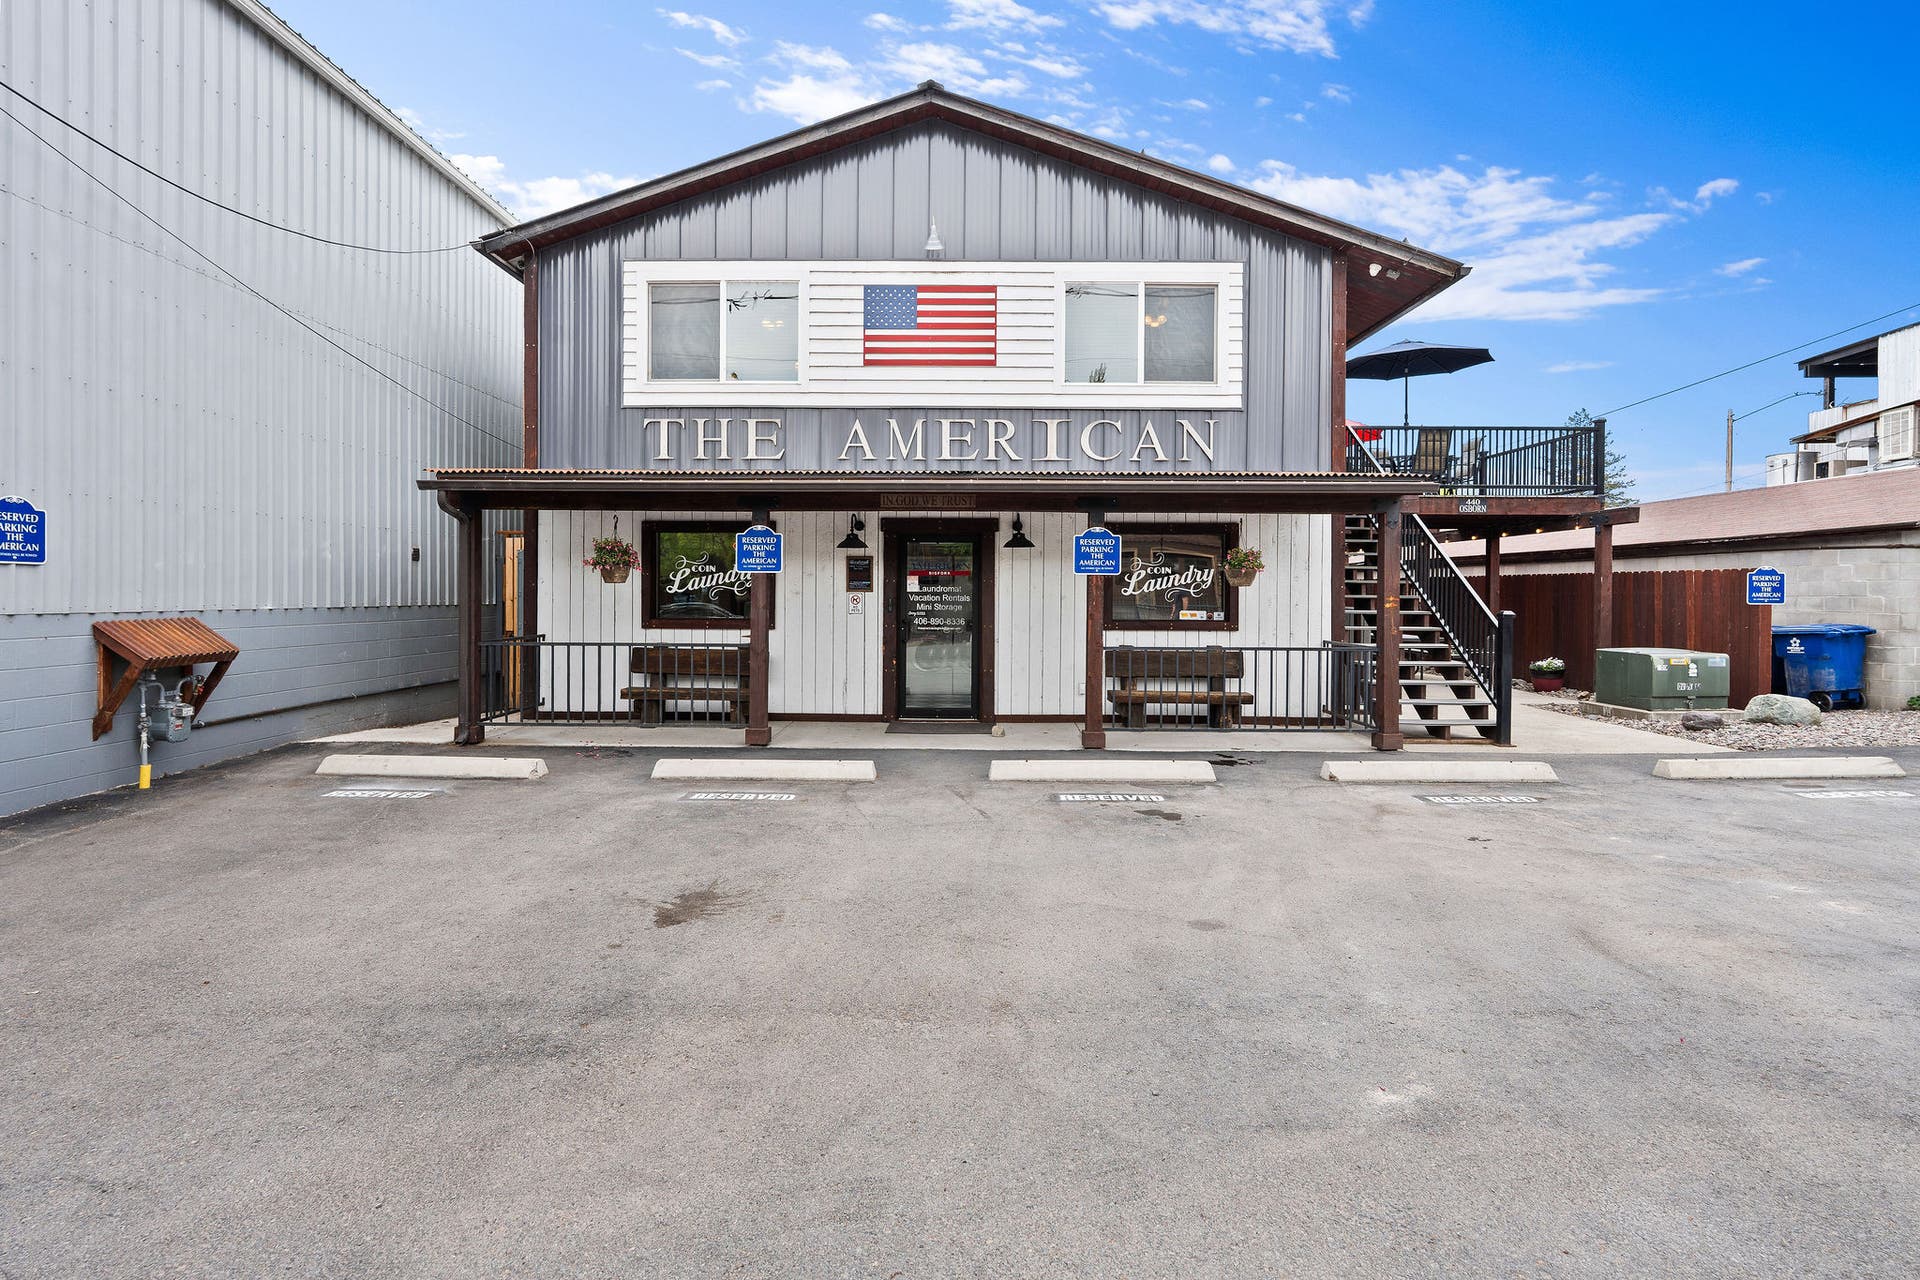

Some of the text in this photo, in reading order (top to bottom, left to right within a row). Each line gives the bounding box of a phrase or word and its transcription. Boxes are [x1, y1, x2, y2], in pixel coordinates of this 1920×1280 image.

[643, 417, 1220, 462] THE AMERICAN
[1459, 505, 1487, 513] OSBORN
[0, 511, 39, 523] SERVED
[0, 522, 37, 534] ARKING
[5, 532, 24, 542] THE
[742, 536, 777, 544] RESERVED
[0, 541, 39, 552] MERICAN
[1079, 538, 1115, 546] RESERVED
[691, 564, 717, 573] COIN
[1147, 566, 1172, 575] COIN
[1121, 564, 1215, 597] Laundry
[942, 594, 971, 602] Rentals
[933, 603, 963, 612] Storage
[689, 792, 796, 800] RESERVED
[1059, 794, 1164, 802] RESERVED
